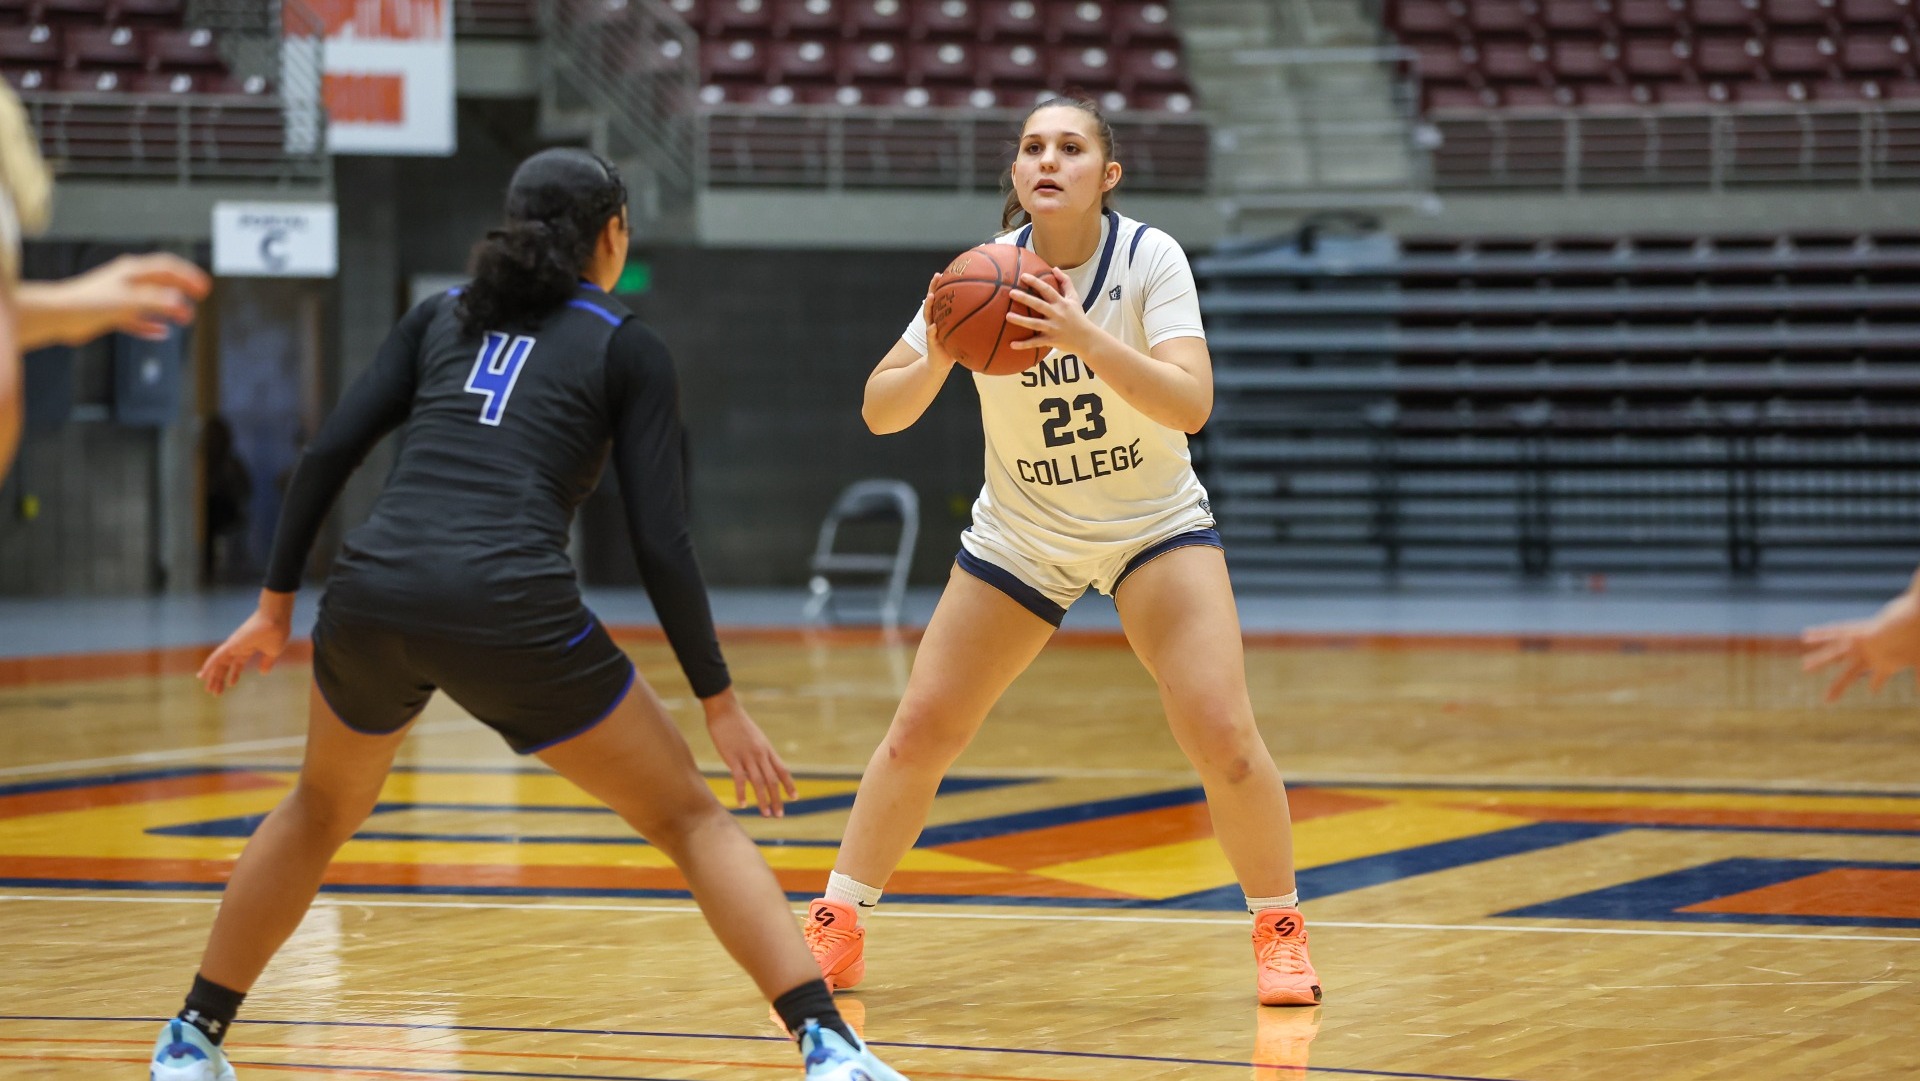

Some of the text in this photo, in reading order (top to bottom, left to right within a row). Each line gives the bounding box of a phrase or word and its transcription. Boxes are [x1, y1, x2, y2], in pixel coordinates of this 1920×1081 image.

[259, 229, 288, 272] C
[464, 331, 536, 426] 4
[1039, 392, 1107, 448] 23
[1016, 437, 1143, 486] COLLEGE
